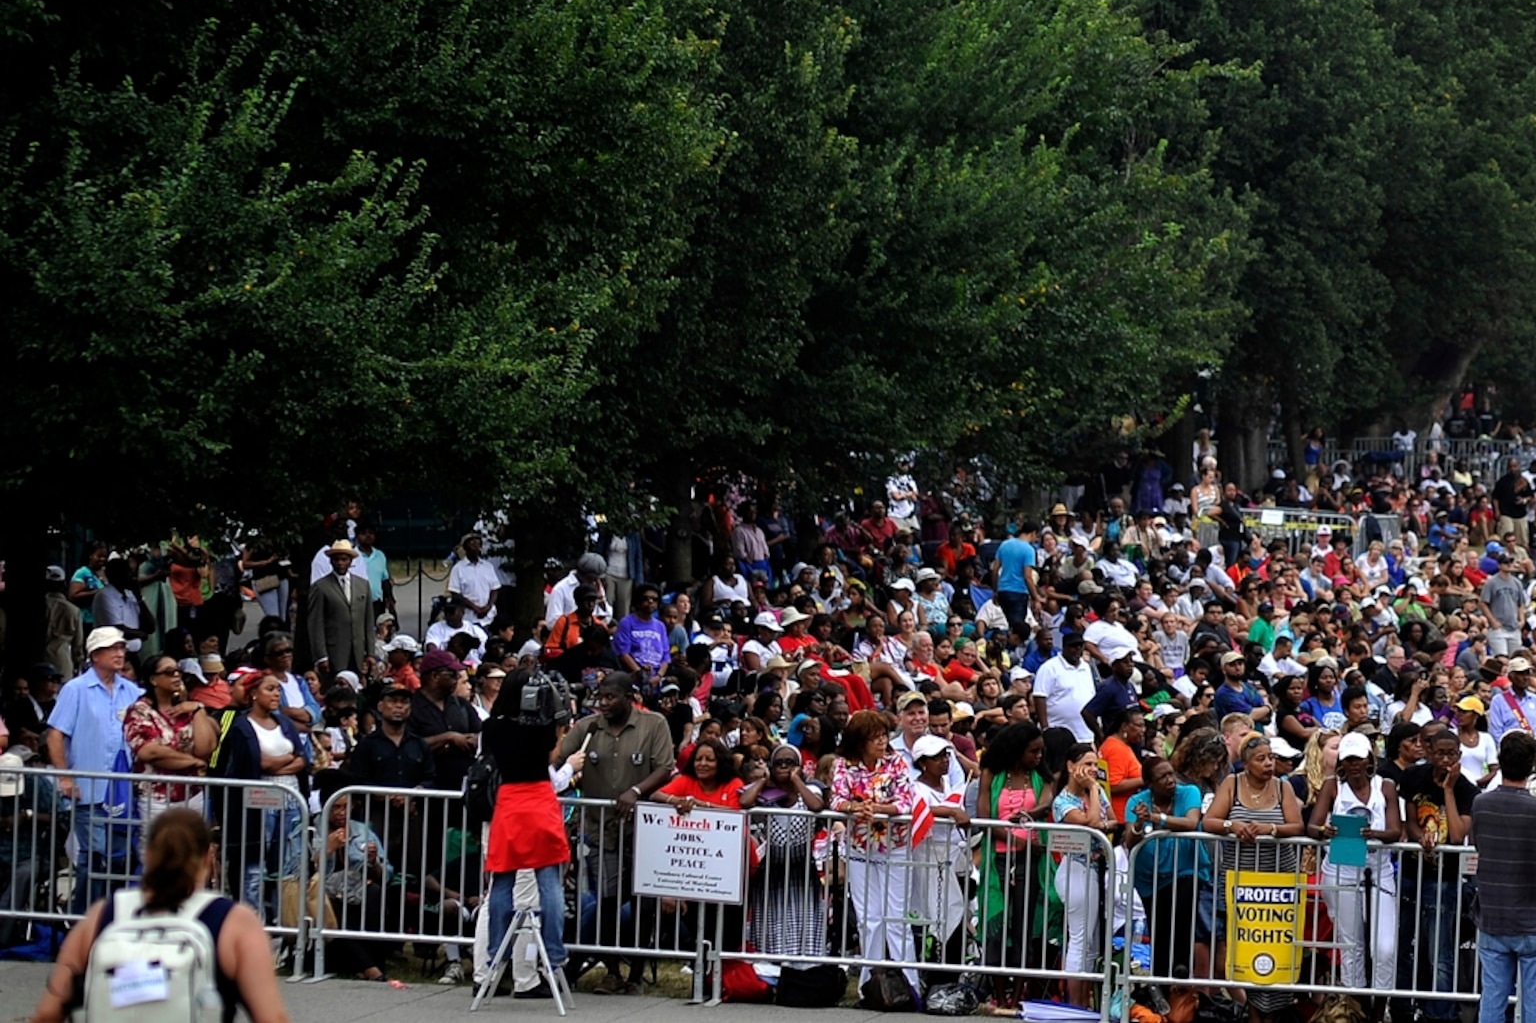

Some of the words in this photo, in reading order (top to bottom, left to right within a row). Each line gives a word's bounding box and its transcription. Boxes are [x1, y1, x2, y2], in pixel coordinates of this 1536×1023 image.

[642, 812, 664, 826] We
[668, 815, 711, 829] March
[715, 820, 739, 832] For
[715, 849, 724, 858] &
[670, 858, 707, 870] PEACE
[1236, 887, 1296, 903] PROTECT
[1235, 906, 1295, 923] VOTING
[1236, 927, 1294, 944] RIGHTS
